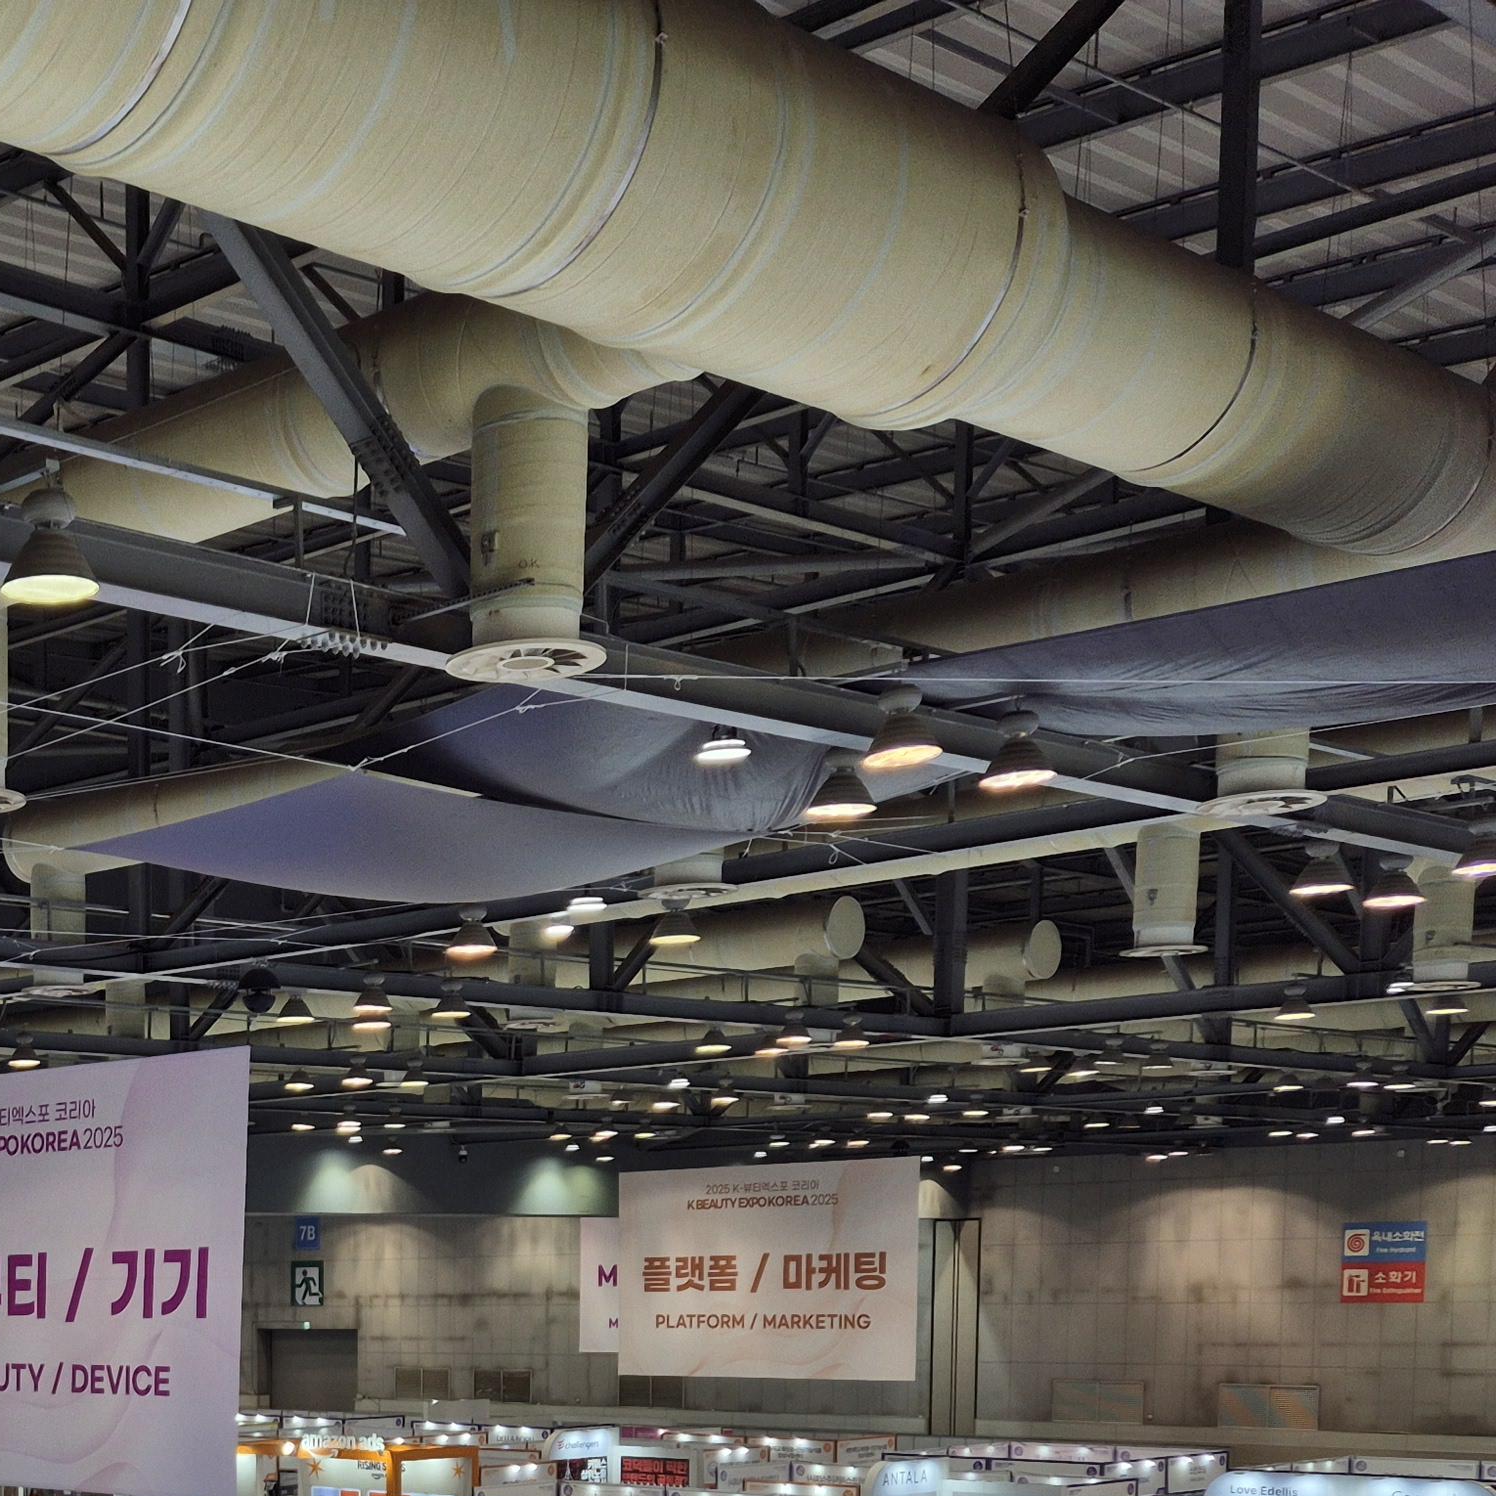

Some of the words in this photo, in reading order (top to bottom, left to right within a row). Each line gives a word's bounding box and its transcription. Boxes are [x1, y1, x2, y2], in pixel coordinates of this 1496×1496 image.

[54, 1099, 96, 1121] 코리아
[21, 1129, 81, 1155] KOREA
[82, 1125, 123, 1149] 2025
[706, 1184, 730, 1194] 2025
[732, 1181, 789, 1193] K-뷰티엑스포
[792, 1179, 820, 1191] 코리아
[810, 1194, 838, 1206] 2025
[299, 1225, 315, 1241] 7B
[642, 1255, 738, 1292] 플랫폼
[750, 1253, 770, 1293] /
[783, 1251, 887, 1291] 마케팅
[1374, 1271, 1416, 1283] 소화기
[65, 1247, 94, 1322] /
[111, 1246, 209, 1319] 기기
[655, 1314, 745, 1329] PLATFORM
[762, 1314, 871, 1329] MARKETING
[51, 1362, 64, 1394] /
[71, 1365, 170, 1396] DEVICE
[302, 1434, 355, 1449] amazon
[358, 1433, 385, 1450] ads
[882, 1469, 928, 1487] ANTALA
[1230, 1484, 1257, 1496] Love
